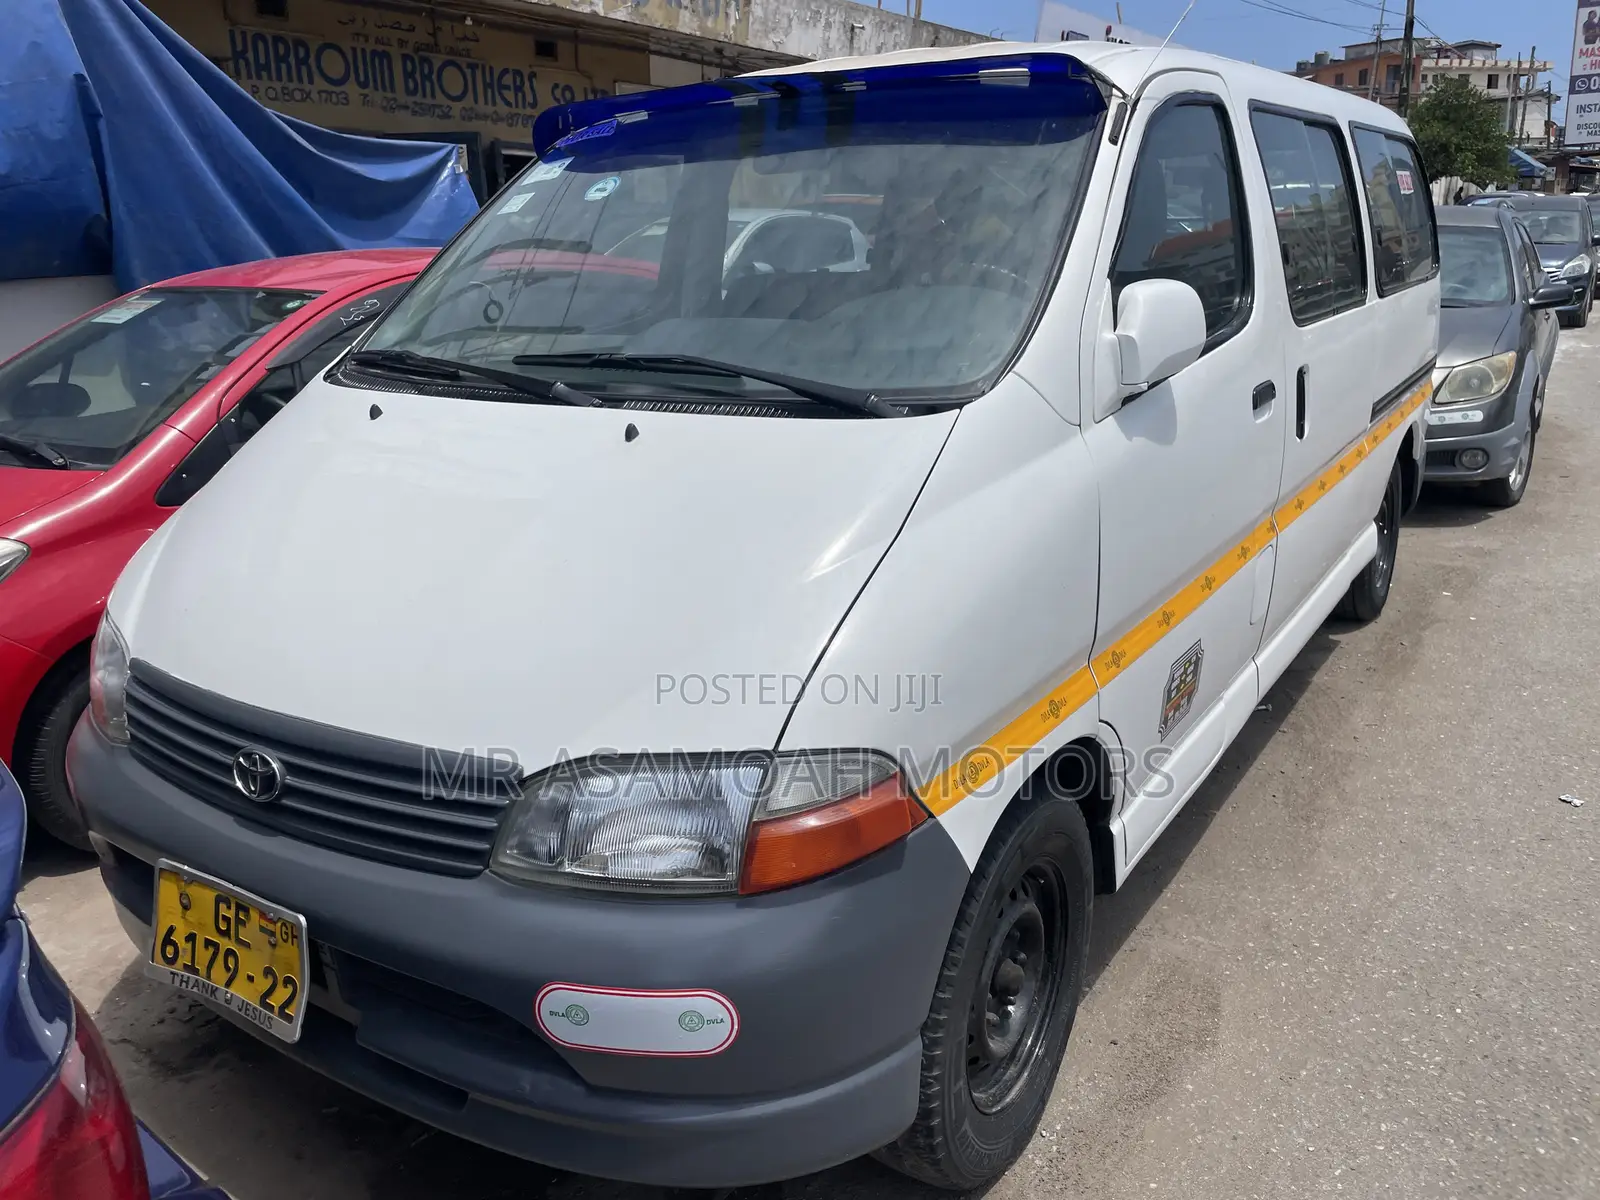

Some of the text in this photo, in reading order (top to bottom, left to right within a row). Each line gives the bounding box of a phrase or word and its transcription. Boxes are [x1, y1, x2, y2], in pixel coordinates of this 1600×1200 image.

[228, 29, 397, 93] KARROUM
[401, 52, 539, 110] BROTHERS
[214, 894, 251, 949] GE
[160, 924, 299, 1025] 6179-22
[169, 971, 219, 1001] THANK
[236, 1001, 275, 1031] JESUS
[549, 1009, 566, 1019] DVLA
[706, 1017, 725, 1026] DVLA
